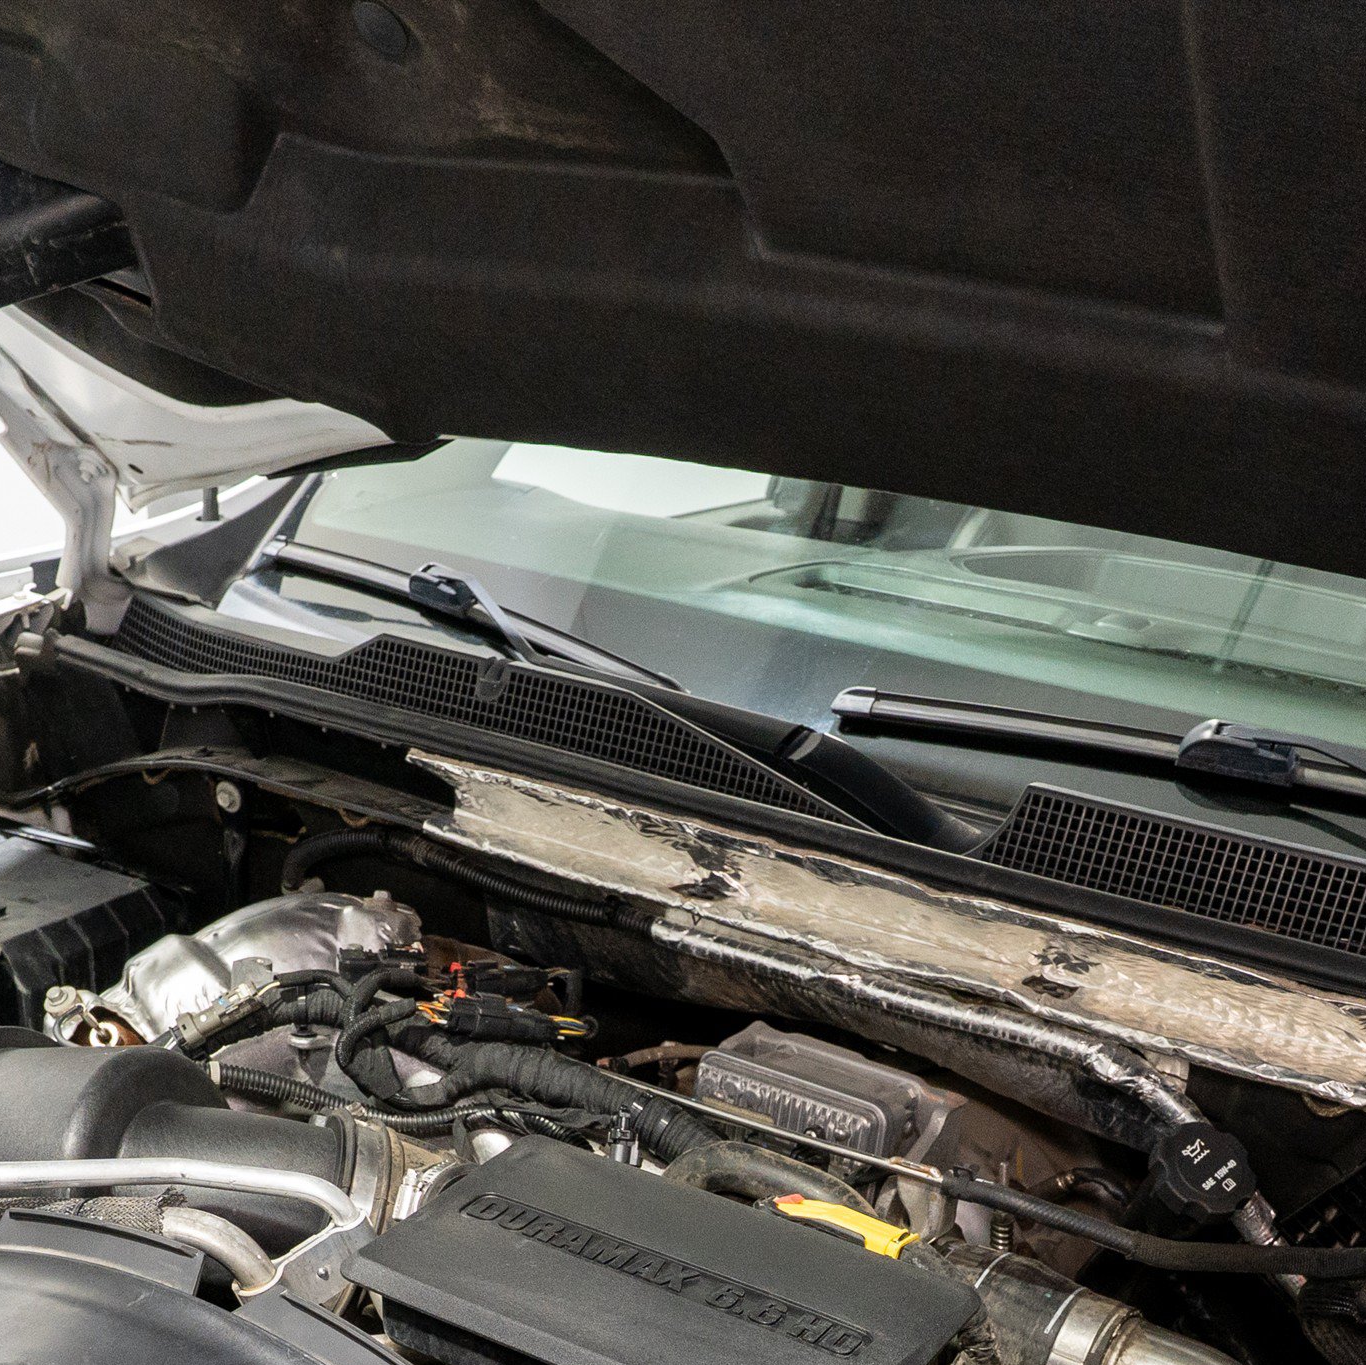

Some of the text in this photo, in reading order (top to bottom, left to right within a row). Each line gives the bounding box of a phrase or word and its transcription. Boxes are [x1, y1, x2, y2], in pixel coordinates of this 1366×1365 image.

[1201, 1159, 1237, 1192] SAE 15W-40
[463, 1192, 701, 1294] DURAMAX
[788, 1314, 869, 1359] HD
